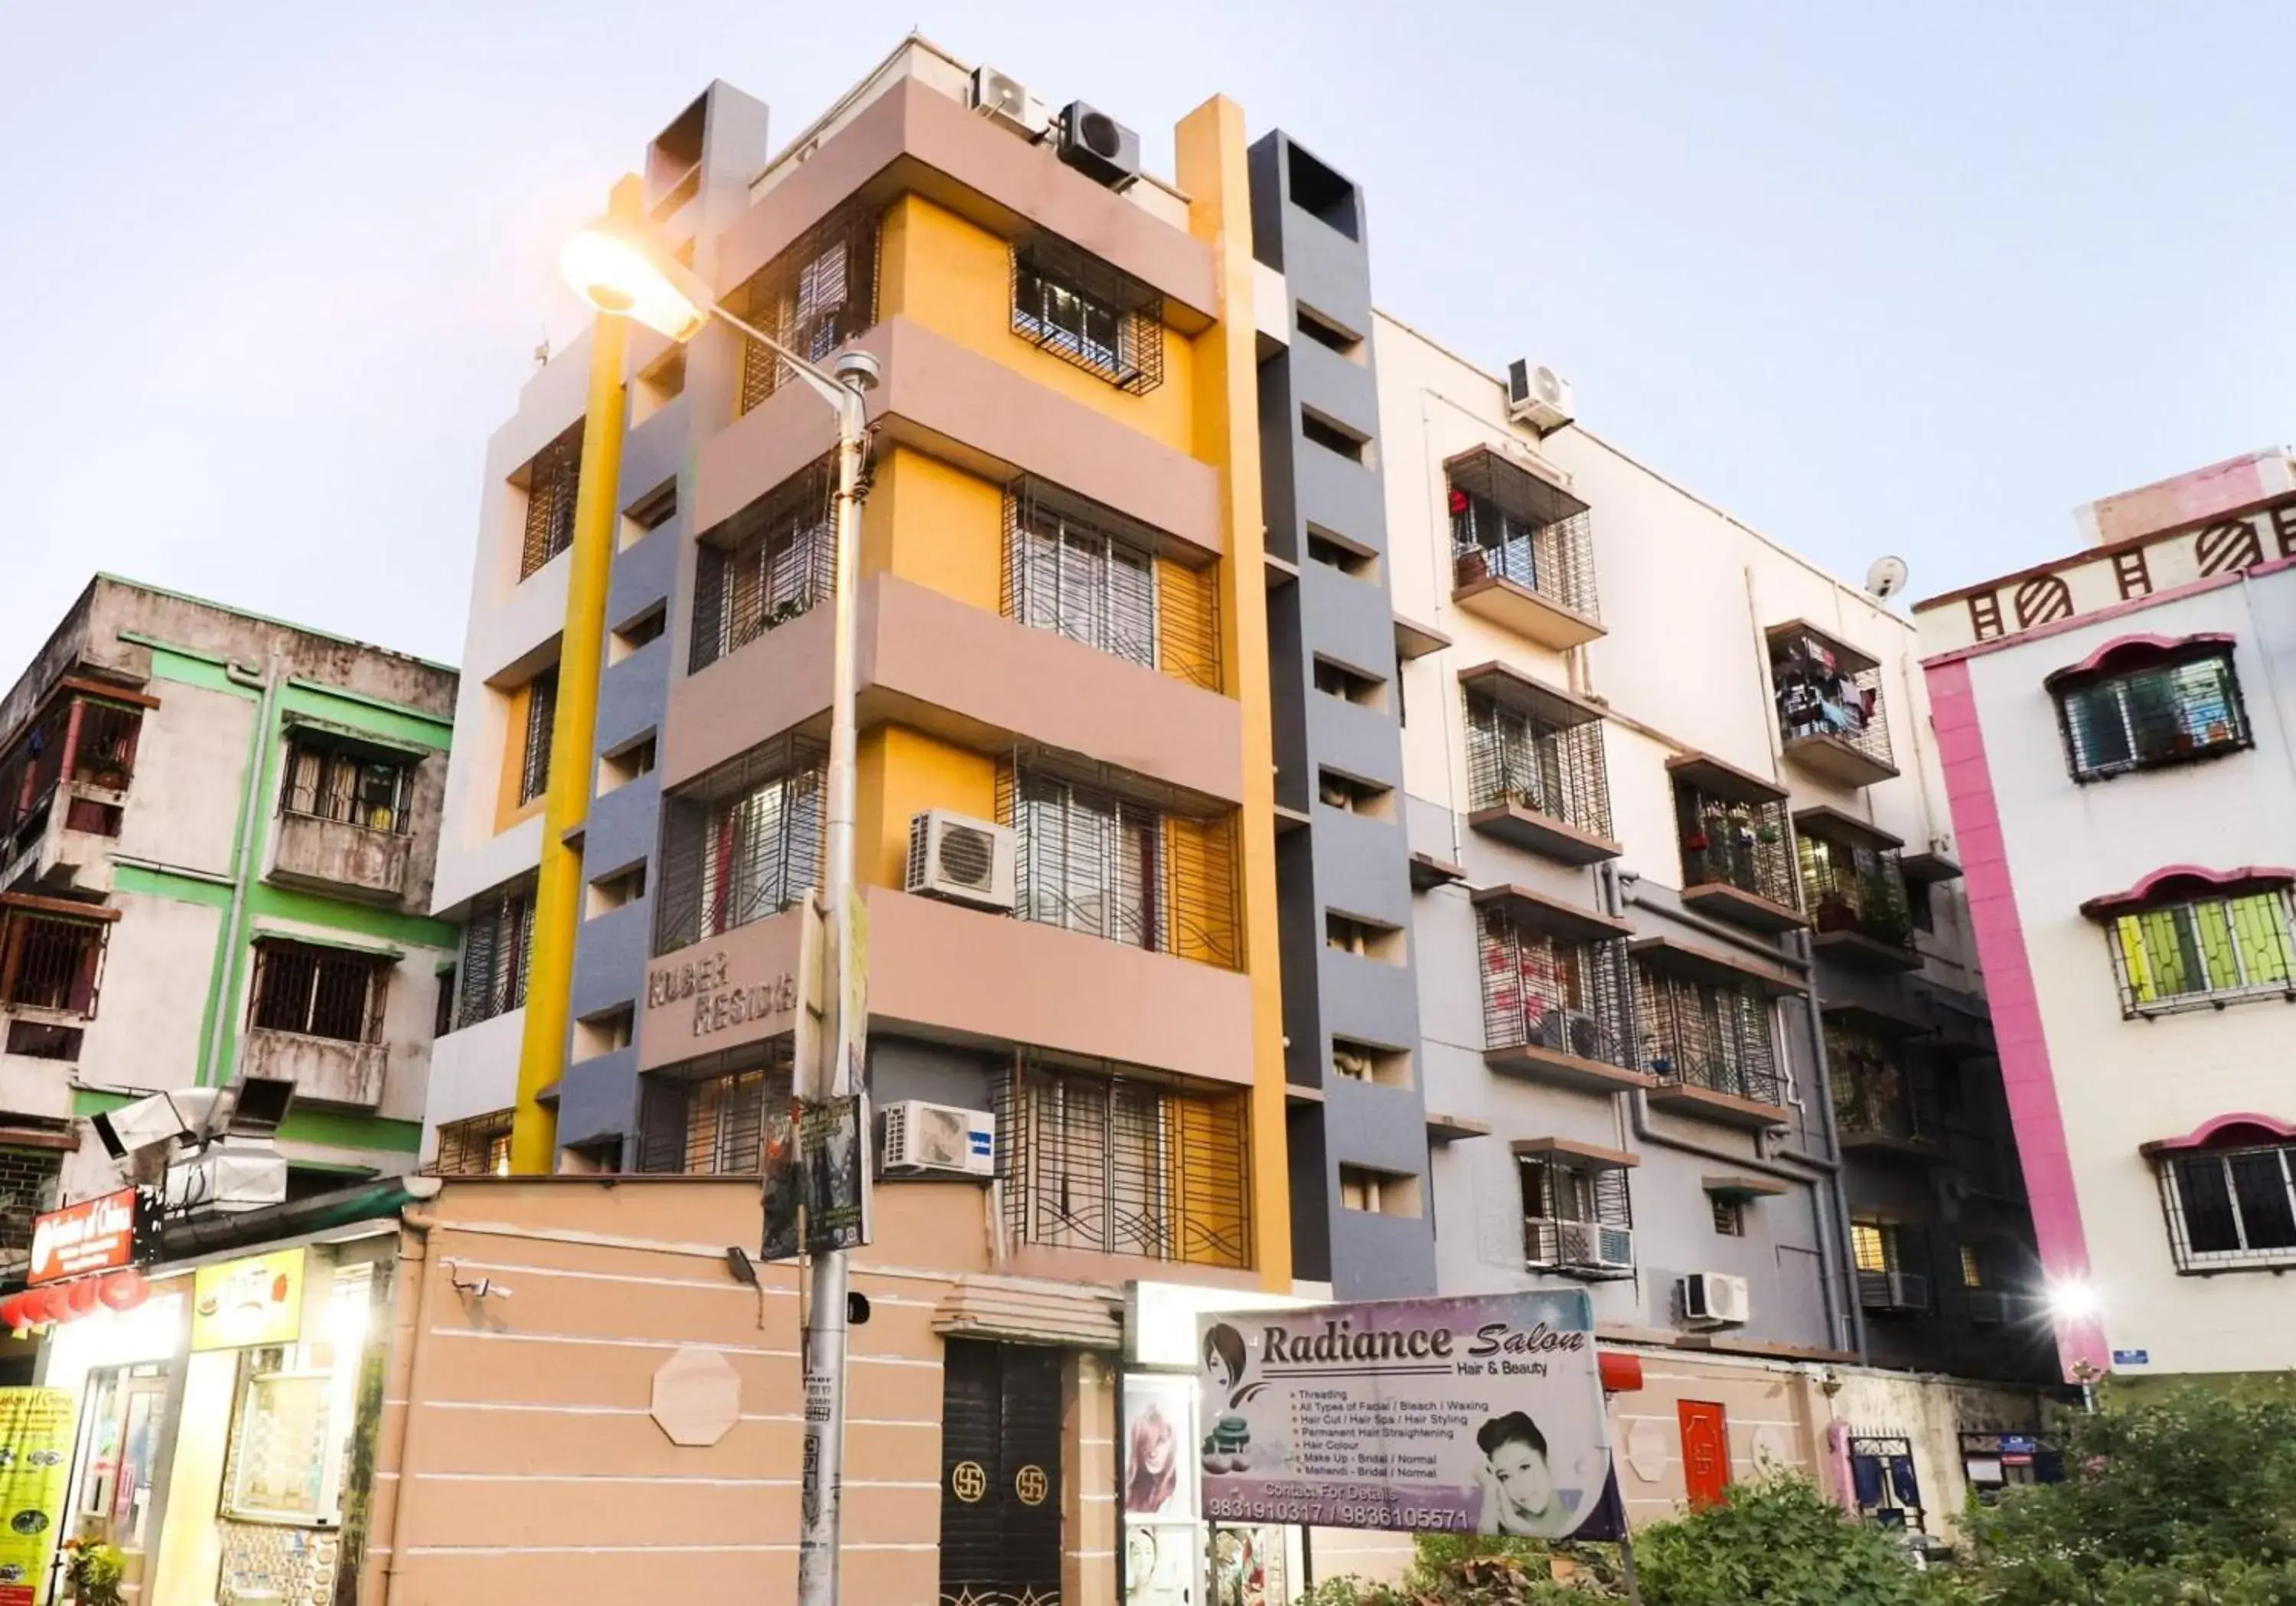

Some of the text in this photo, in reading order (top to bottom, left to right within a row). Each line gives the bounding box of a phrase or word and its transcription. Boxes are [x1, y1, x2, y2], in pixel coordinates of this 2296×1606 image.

[693, 971, 797, 1037] RESIDE
[1261, 1320, 1585, 1363] Radiance Salon
[1457, 1360, 1547, 1377] Hair & Beauty
[1299, 1389, 1348, 1401] Threading
[1314, 1402, 1344, 1413] Types
[1346, 1402, 1356, 1411] of
[1358, 1402, 1391, 1412] Facial
[1400, 1401, 1437, 1411] Bleach
[1445, 1400, 1489, 1412] Waxing
[1300, 1415, 1321, 1424] Hair
[1322, 1415, 1342, 1425] Cut
[1349, 1415, 1371, 1424] Hair
[1374, 1414, 1394, 1425] Spa
[1404, 1414, 1427, 1424] Hair
[1430, 1414, 1468, 1426] Styling
[1302, 1427, 1454, 1440] Permanent Hair Straightening
[1303, 1440, 1359, 1451] Hair Colour
[1303, 1453, 1331, 1463] Make
[1334, 1454, 1349, 1464] Up
[1358, 1454, 1388, 1464] Bridal
[1397, 1454, 1437, 1464] Normal
[1357, 1466, 1388, 1477] Bridal
[1397, 1467, 1437, 1478] Normal
[1264, 1480, 1398, 1503] Contact For Details
[1209, 1497, 1322, 1522] 9831910317
[1341, 1506, 1469, 1529] 9836105571
